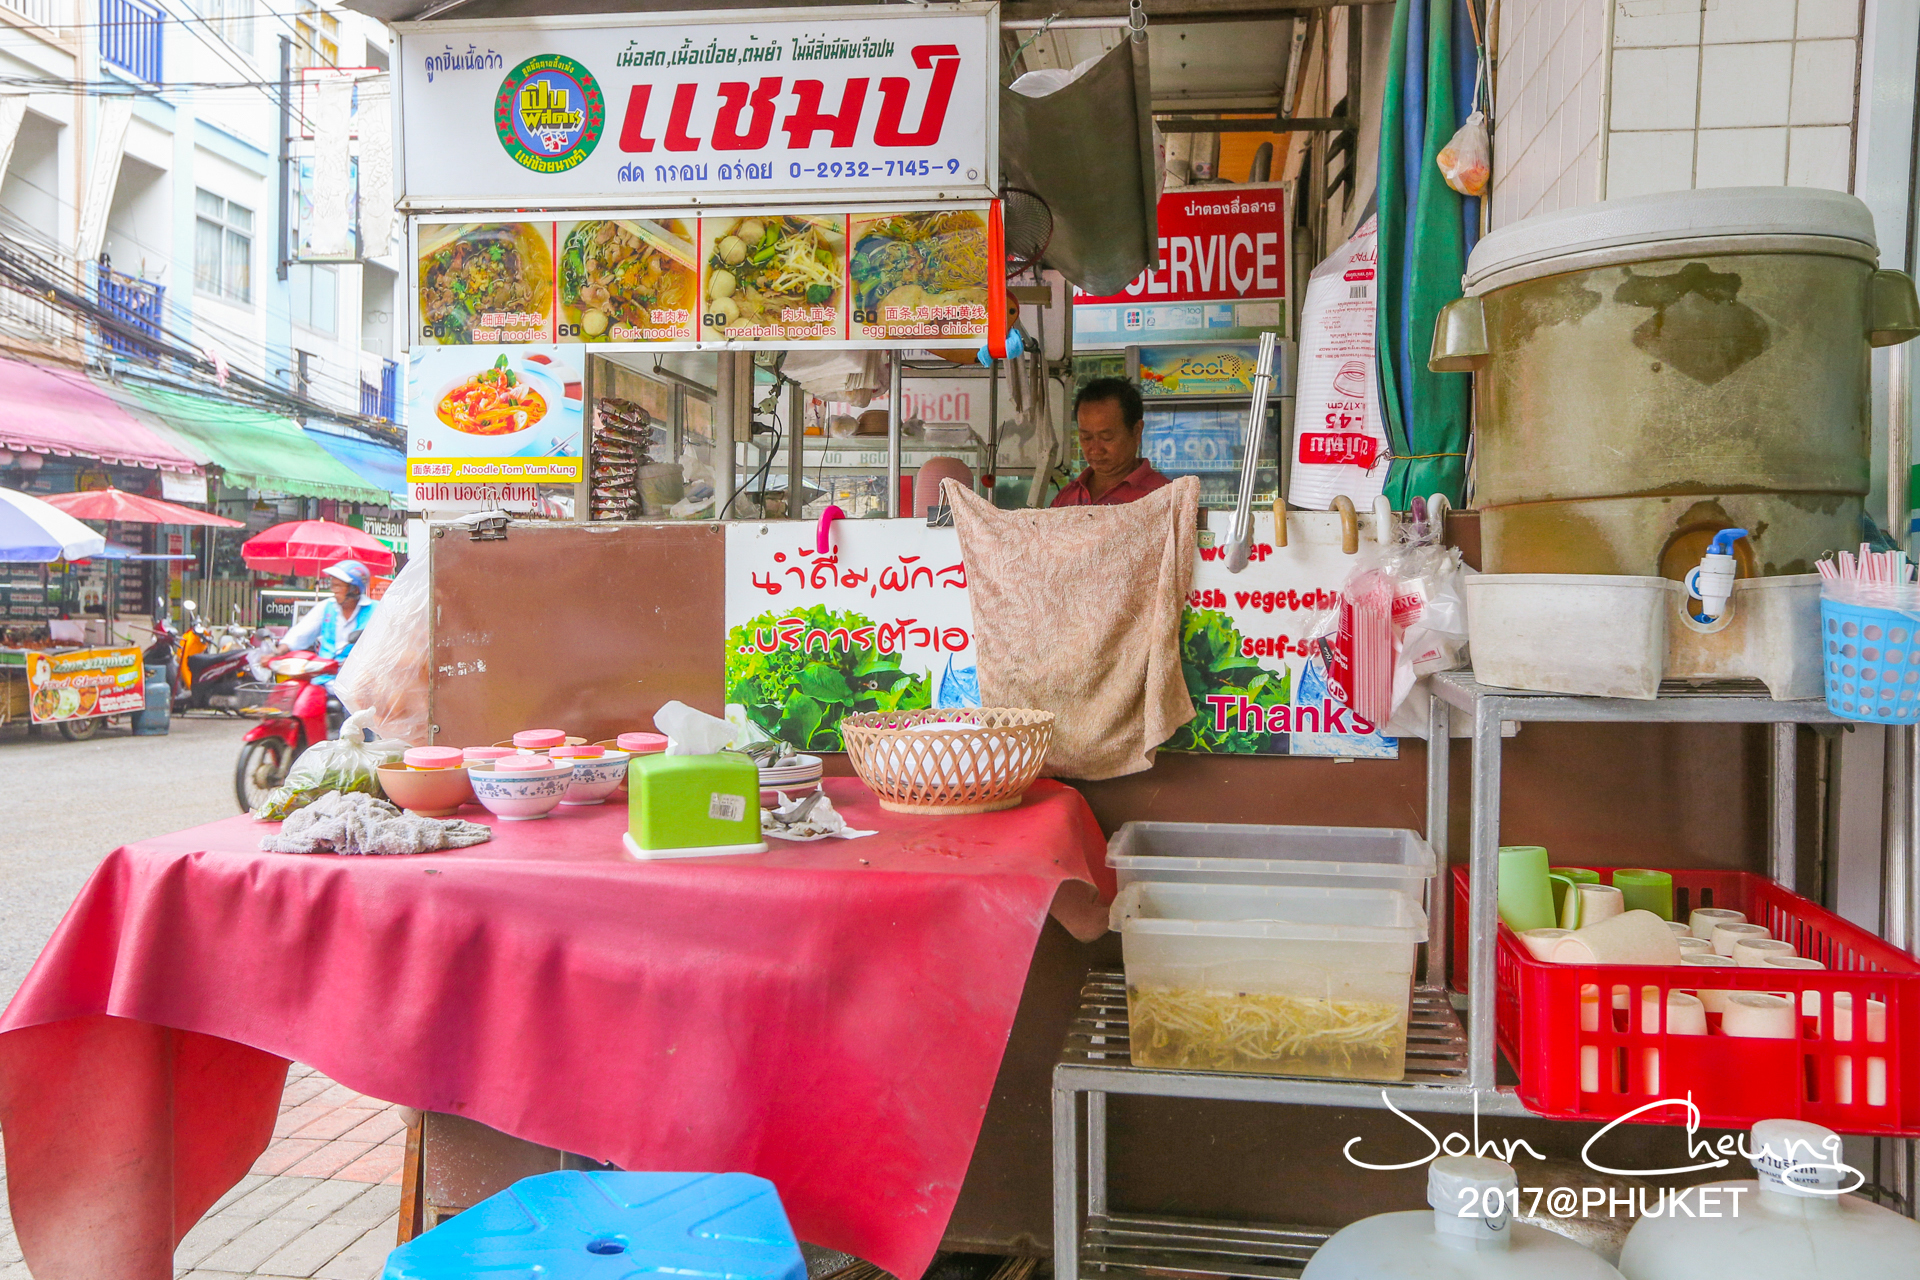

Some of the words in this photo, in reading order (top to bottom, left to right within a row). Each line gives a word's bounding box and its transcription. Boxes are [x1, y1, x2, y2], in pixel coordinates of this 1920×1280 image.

[425, 44, 503, 83] ลูกชิ้นเนื้อวัว
[618, 44, 962, 153] แชมป์
[617, 163, 645, 184] สด
[655, 163, 708, 183] กรอบ
[717, 158, 773, 181] อร่อย
[789, 158, 961, 180] 0-2932-7145-9
[1184, 195, 1277, 216] ป่าตองสื่อสาร
[651, 310, 688, 323] 猪肉粉
[703, 313, 727, 326] 60
[782, 308, 836, 322] 肉丸,面条
[853, 310, 878, 323] 60
[423, 325, 446, 338] 60
[473, 330, 500, 341] Beef
[502, 330, 547, 340] noodles
[558, 324, 581, 336] 60
[613, 327, 641, 338] Pork
[644, 326, 691, 338] noodles
[726, 324, 785, 336] meatballs
[788, 324, 837, 336] noodles
[862, 326, 886, 338] egg
[889, 323, 938, 336] noodles
[412, 464, 452, 476] 面条汤虾
[462, 464, 499, 475] Noodle
[502, 464, 522, 475] Tom
[524, 464, 547, 475] Yum
[549, 464, 576, 477] Kung
[738, 617, 975, 655] ..บริการตัวเอ
[1206, 694, 1375, 734] Thanks
